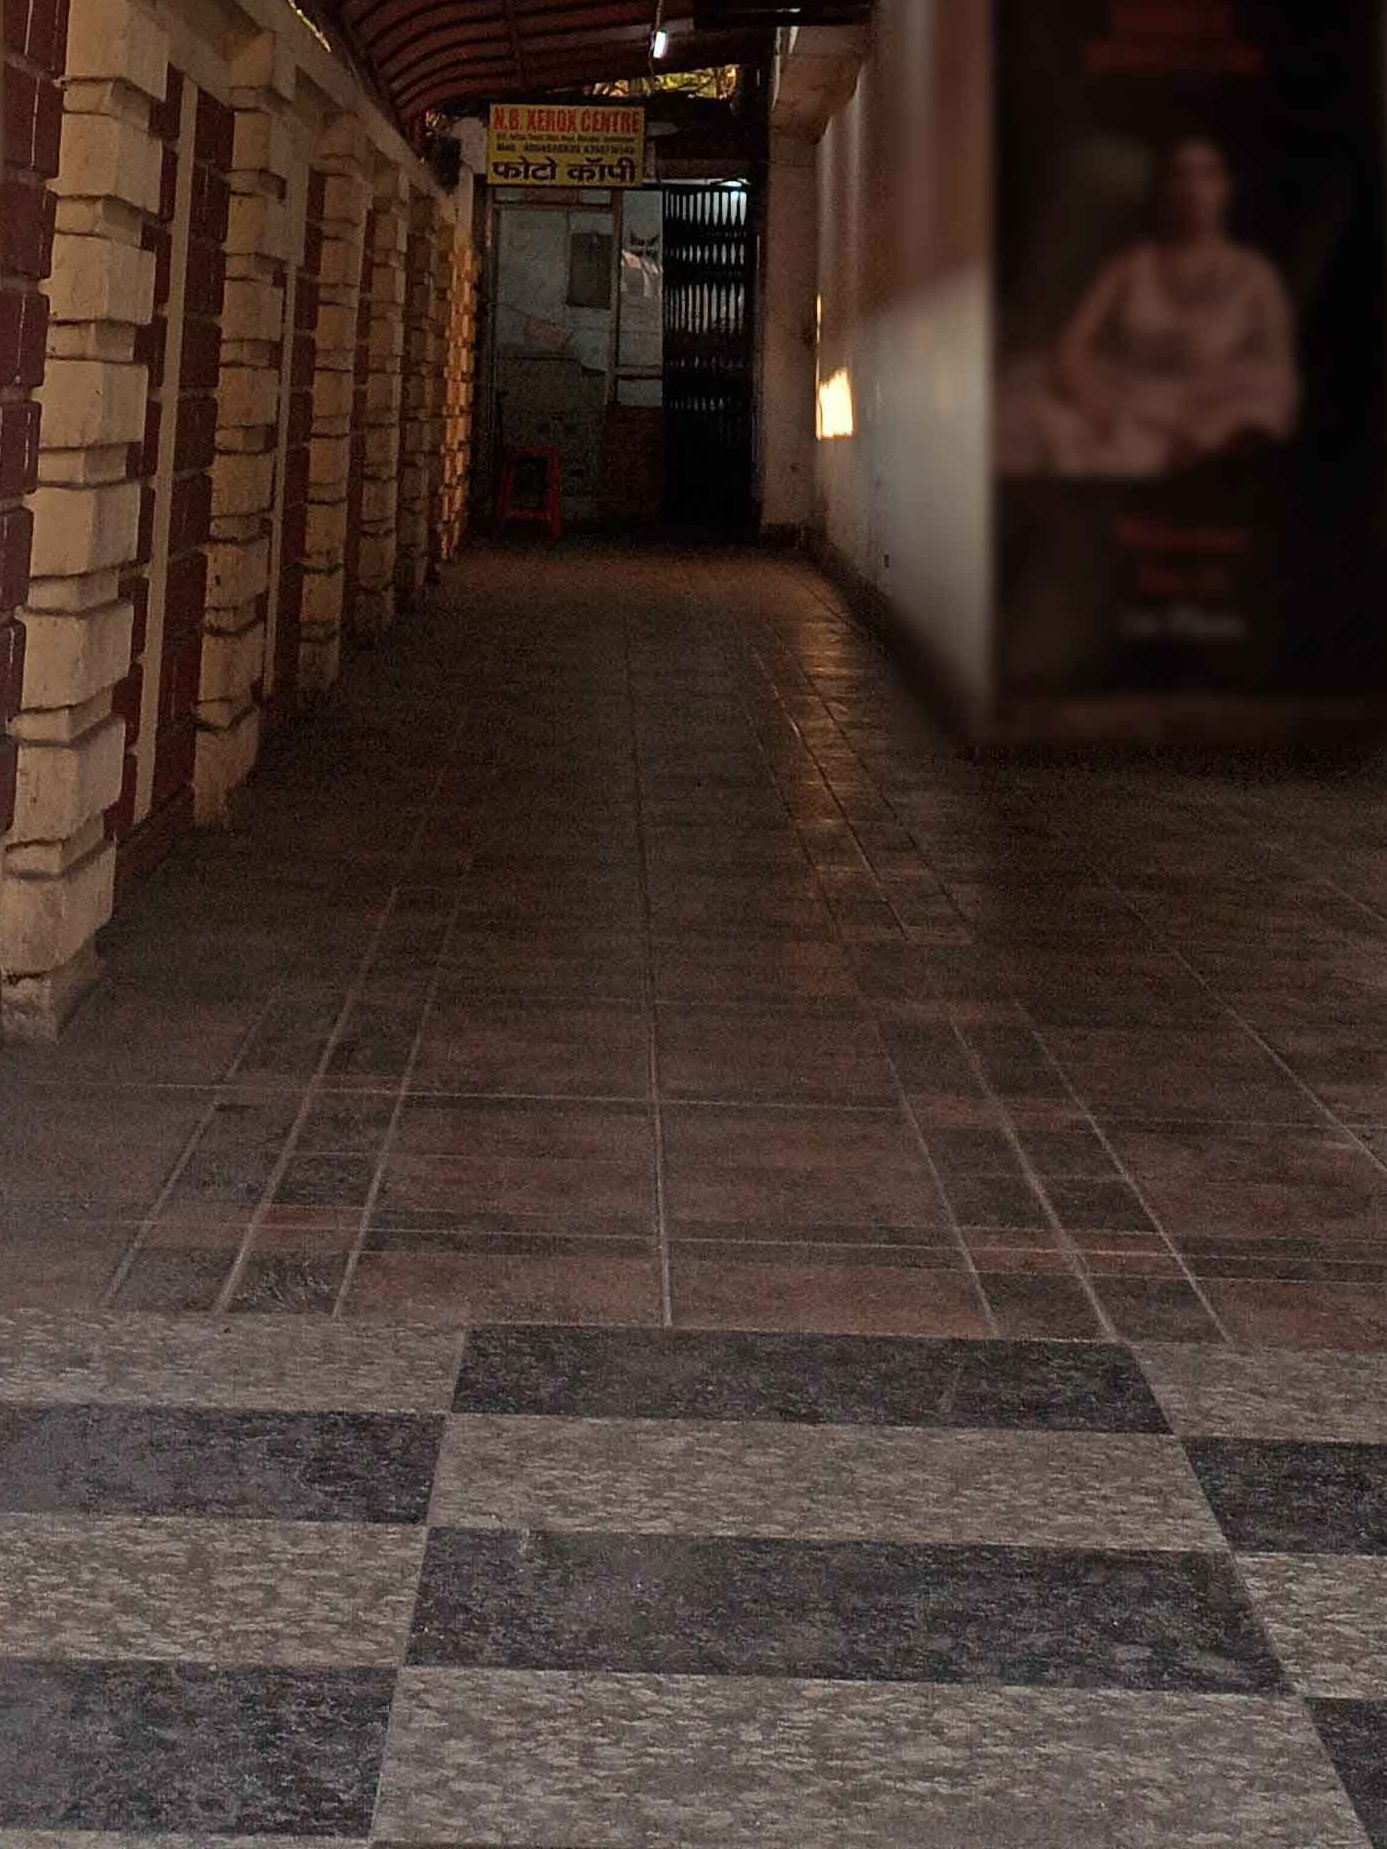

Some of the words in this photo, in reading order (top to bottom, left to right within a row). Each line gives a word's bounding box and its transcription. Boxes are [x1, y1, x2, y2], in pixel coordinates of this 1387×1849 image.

[527, 108, 576, 132] XEROX
[580, 109, 640, 134] CENTRE
[493, 156, 558, 181] फोटो
[566, 156, 636, 182] कॉपी
